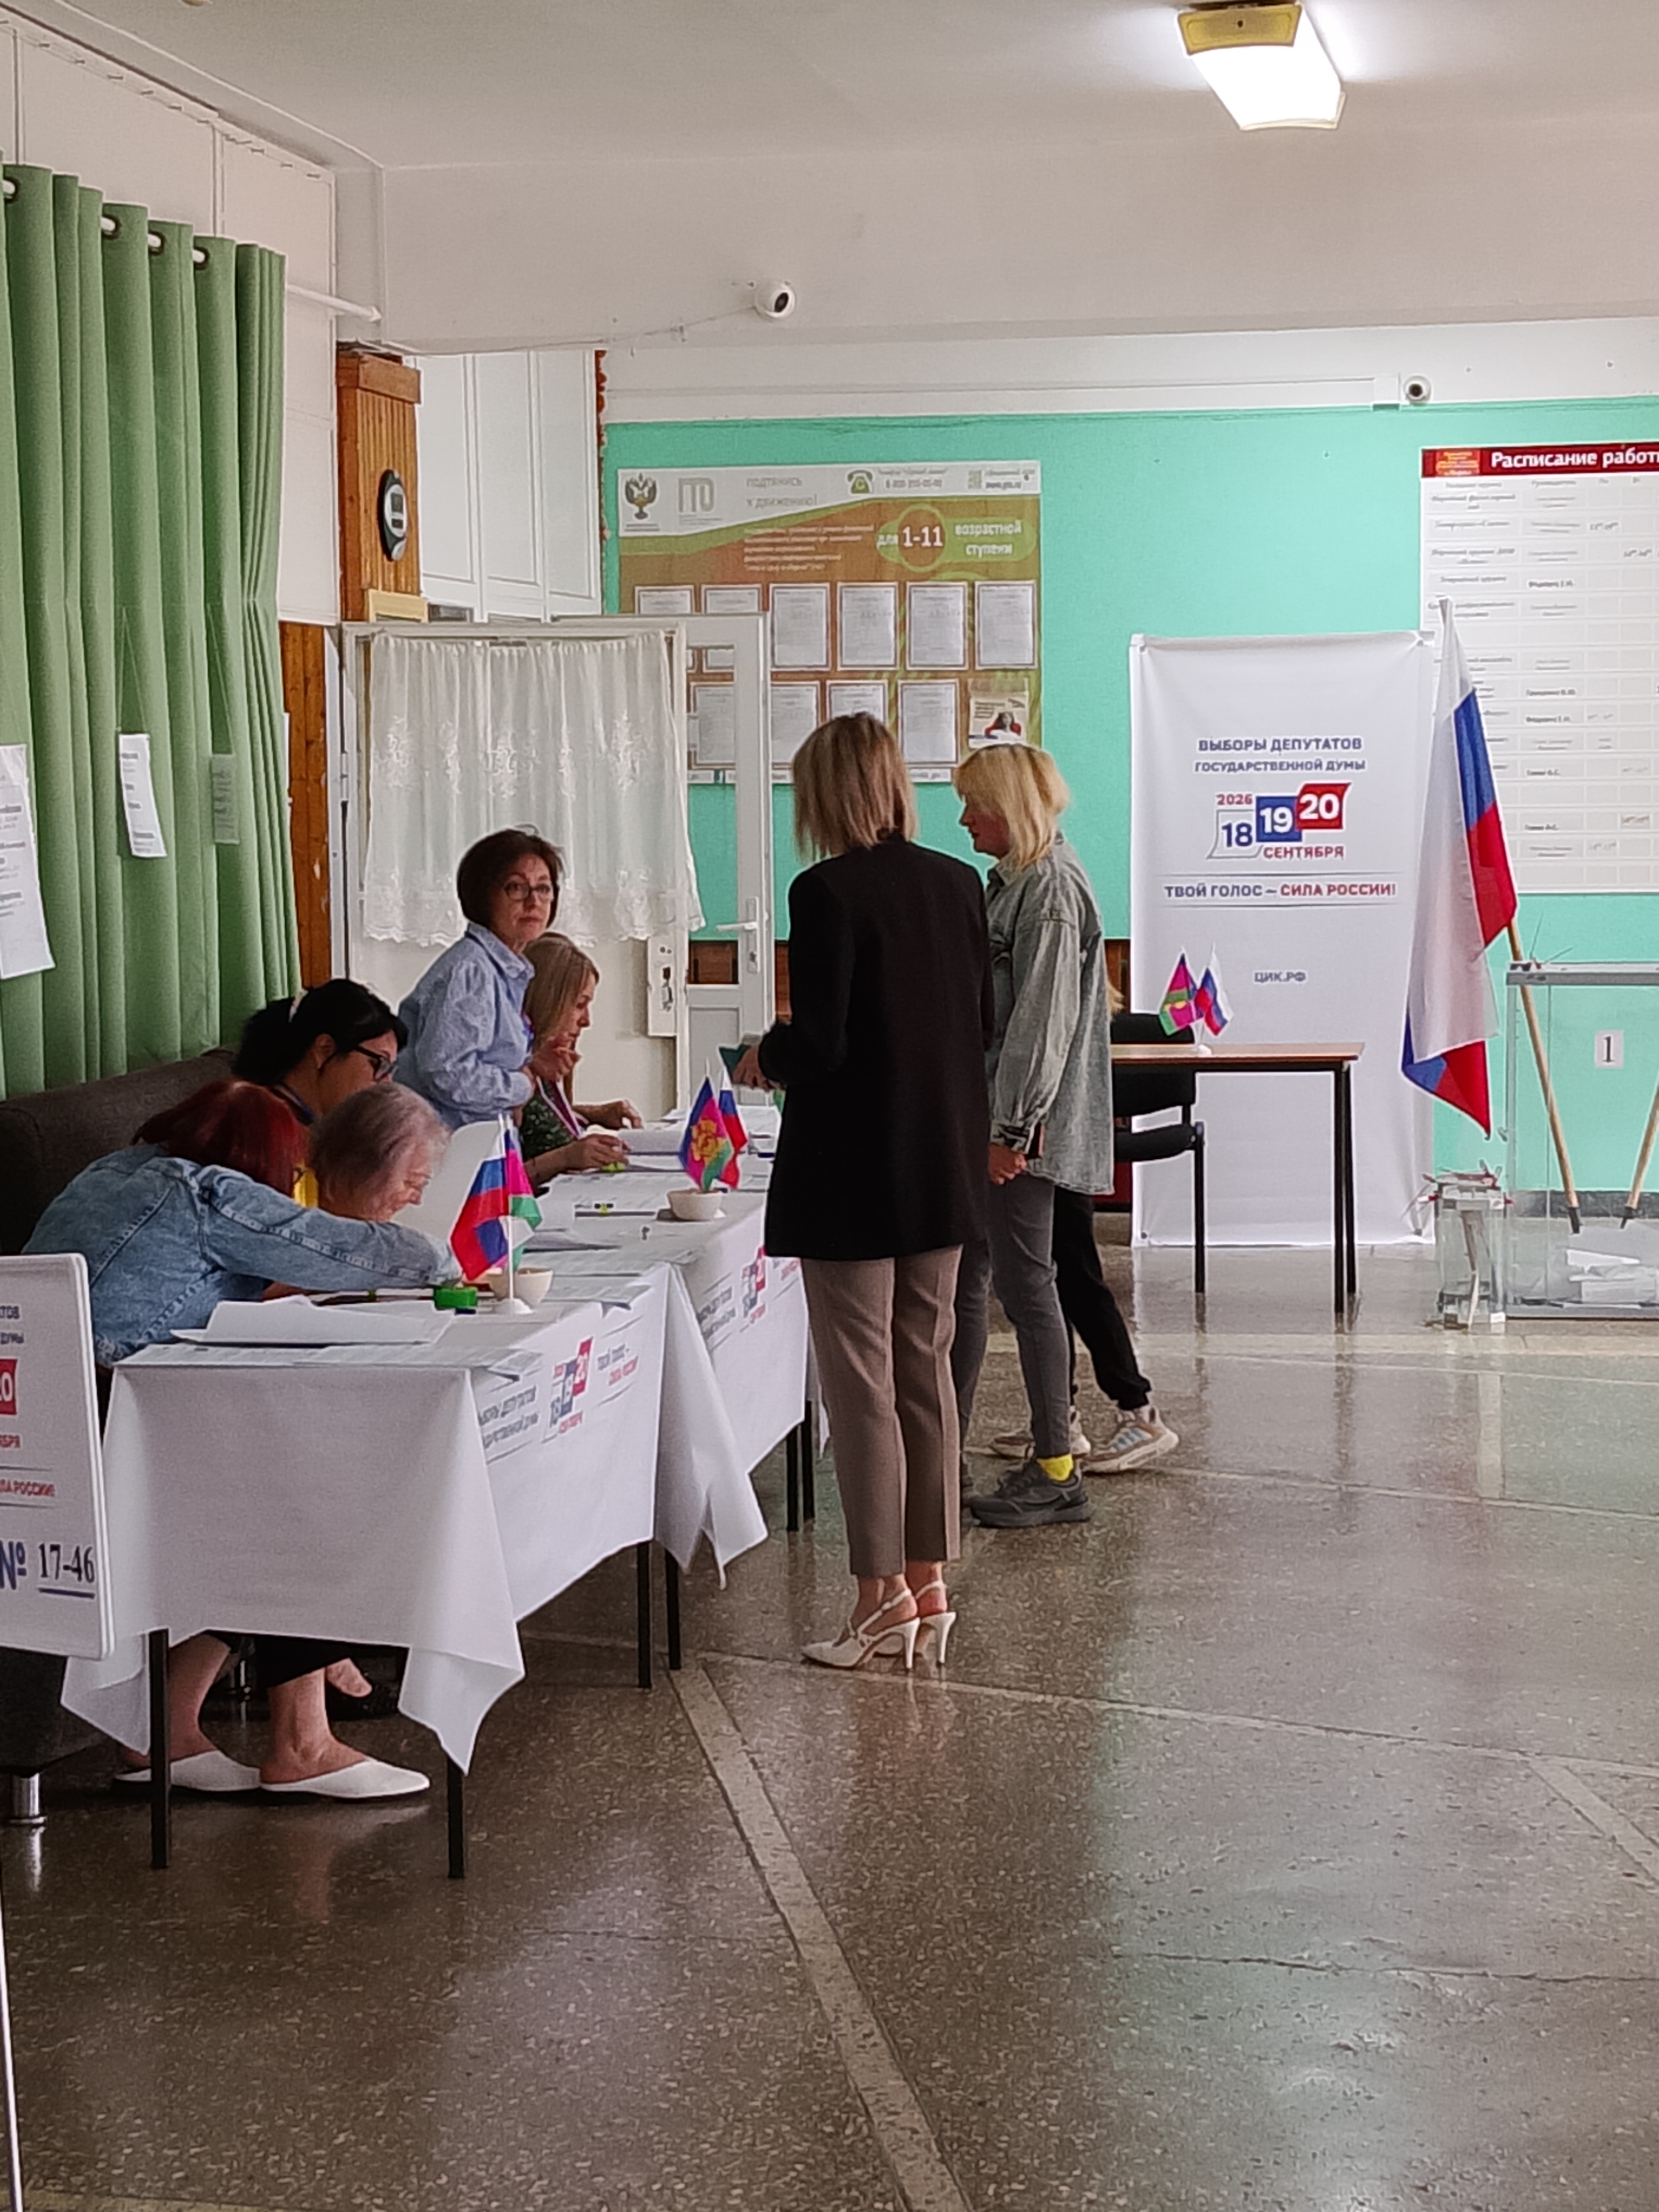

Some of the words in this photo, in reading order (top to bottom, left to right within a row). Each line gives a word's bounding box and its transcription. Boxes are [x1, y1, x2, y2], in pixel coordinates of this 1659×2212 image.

[1492, 452, 1597, 468] Расписание
[955, 520, 1022, 536] возрастной
[902, 526, 943, 547] 1-11
[1198, 739, 1266, 751] ВЫБОРЫ
[1270, 738, 1362, 752] ДЕПУТАТОВ
[1195, 759, 1323, 773] ГОСУДАРСТВЕННОЙ
[1325, 760, 1365, 772] ДУМЫ
[1216, 794, 1253, 805] 2026
[1222, 822, 1253, 847] 18
[1260, 807, 1293, 833] 19
[1299, 793, 1339, 819] 20
[1263, 846, 1344, 859] СЕНТЯБРЯ
[1164, 883, 1206, 898] ТВОЙ
[1211, 885, 1262, 897] ГОЛОС
[1280, 884, 1323, 896] СИЛА
[1326, 884, 1396, 896] РОССИИ!
[1255, 972, 1306, 983] ЦИК.РФ
[1602, 1036, 1615, 1063] 1
[0, 1541, 26, 1589] №
[39, 1542, 95, 1584] 17-46
